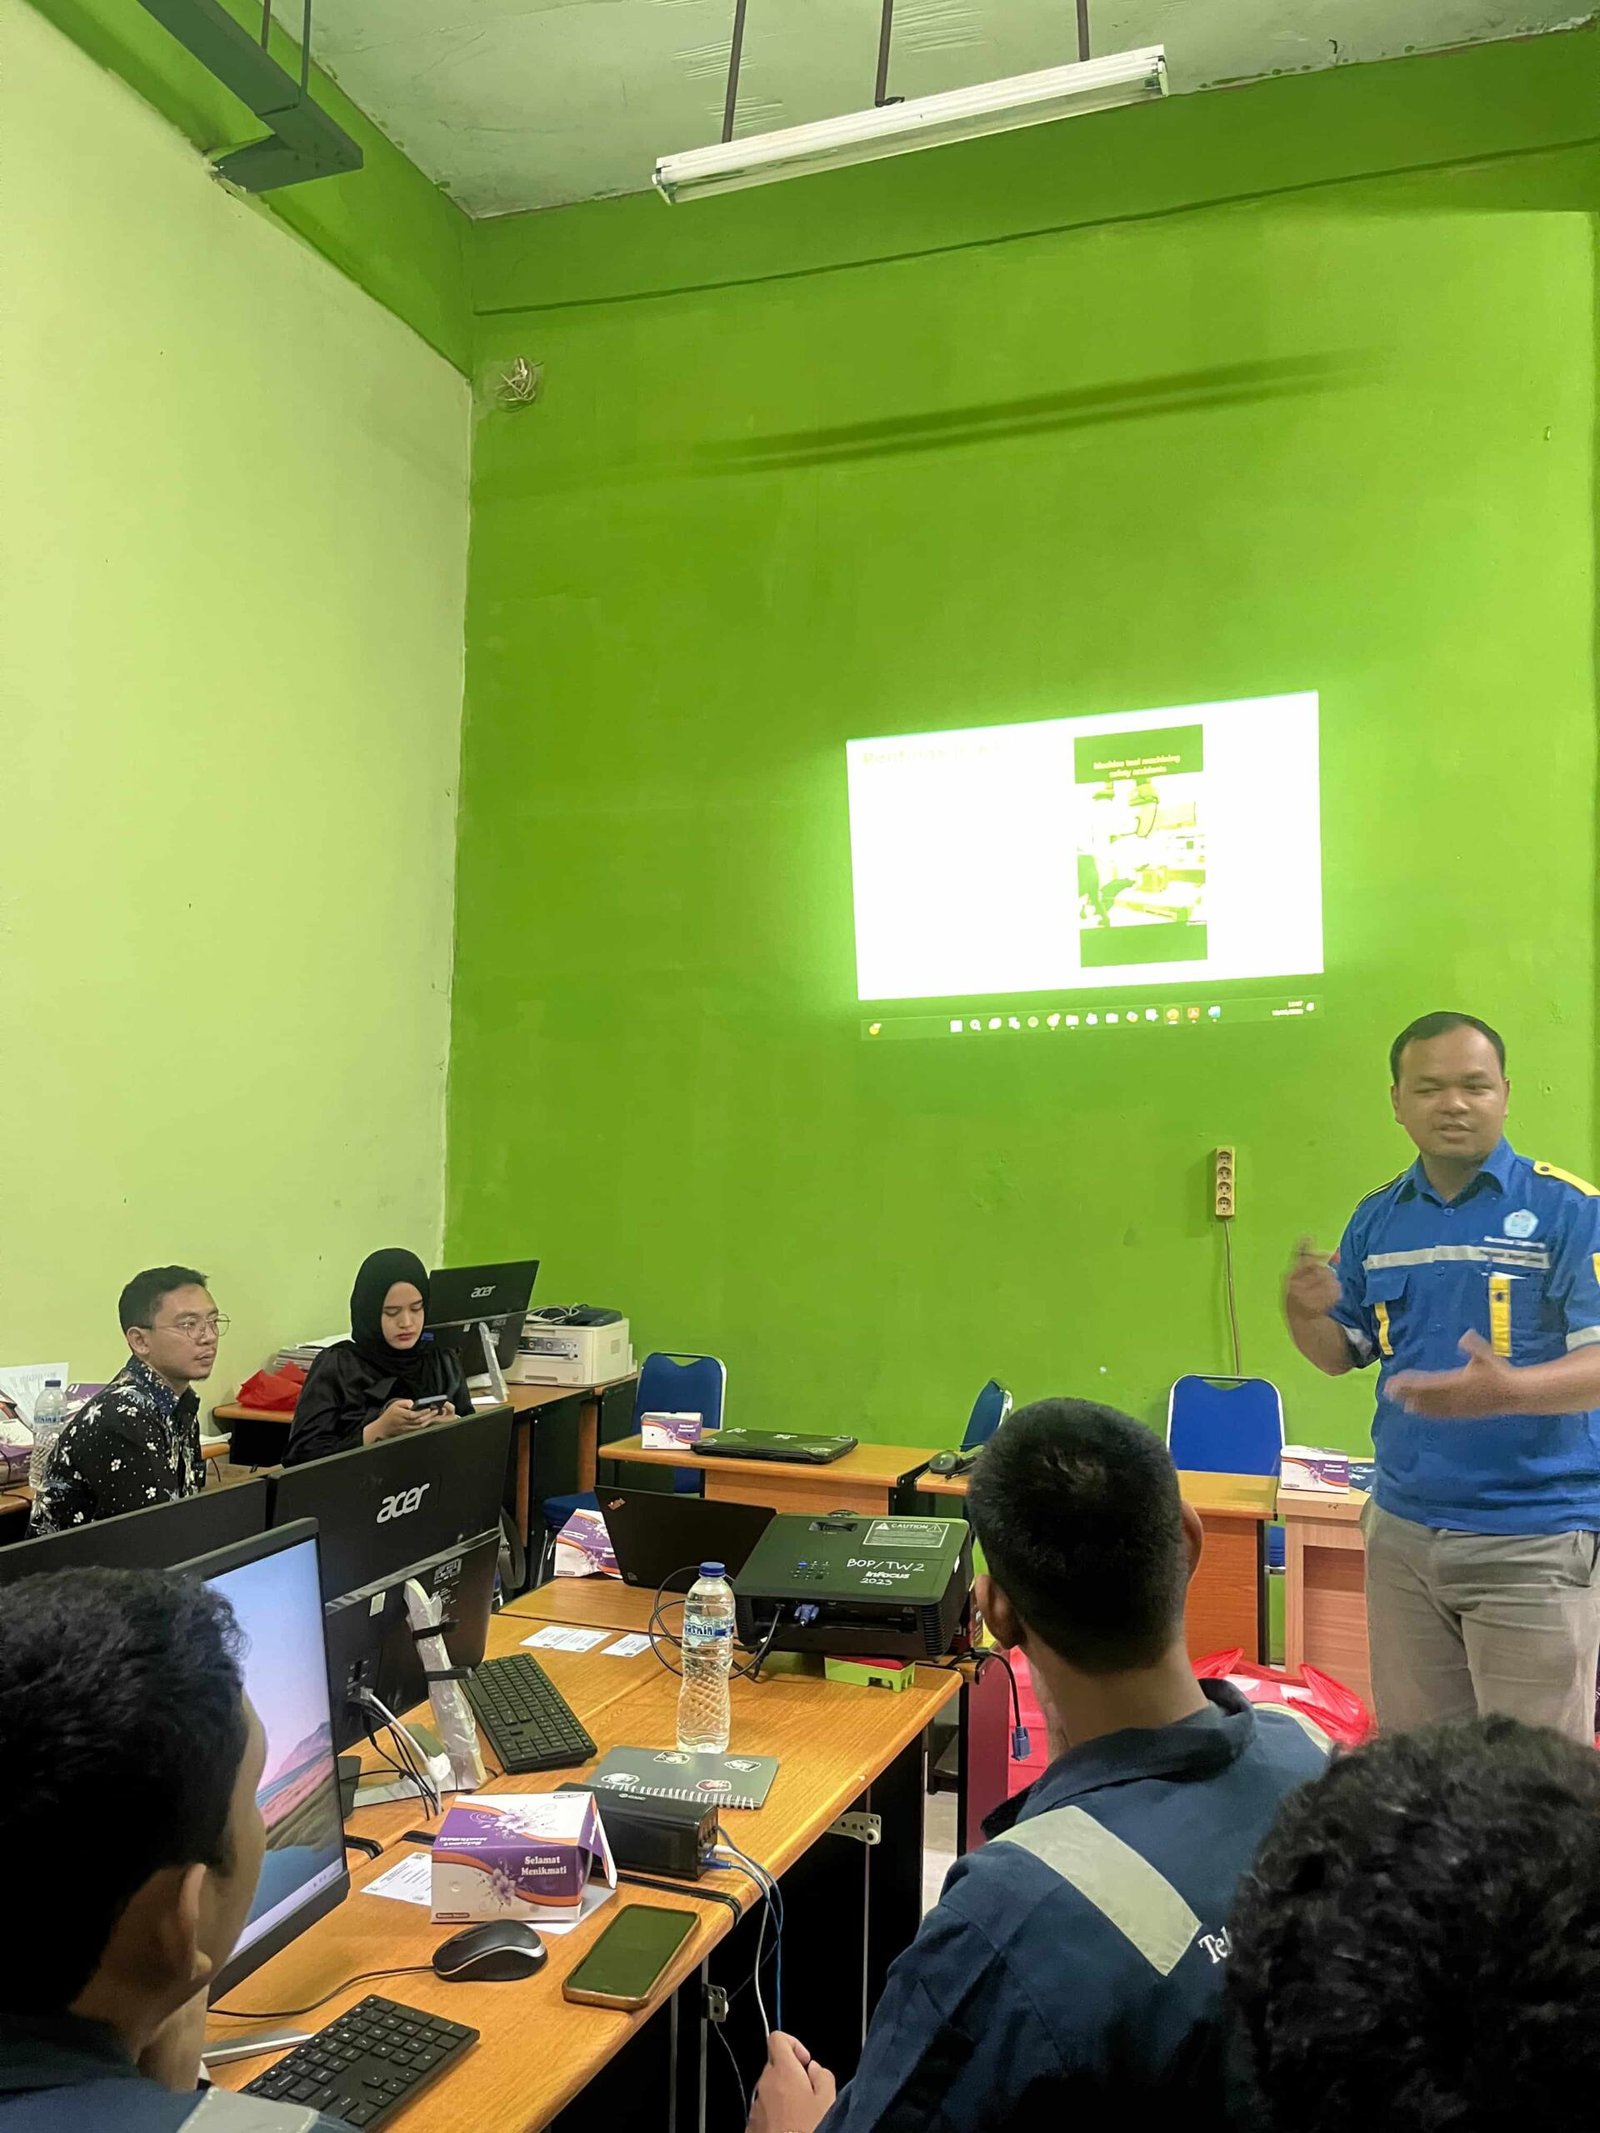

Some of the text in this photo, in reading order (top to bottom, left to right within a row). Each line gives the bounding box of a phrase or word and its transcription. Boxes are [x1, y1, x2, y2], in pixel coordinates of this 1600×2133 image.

[470, 1285, 497, 1299] acer
[376, 1483, 431, 1524] acer
[524, 1855, 561, 1865] Selamat
[521, 1866, 567, 1876] Menikmati
